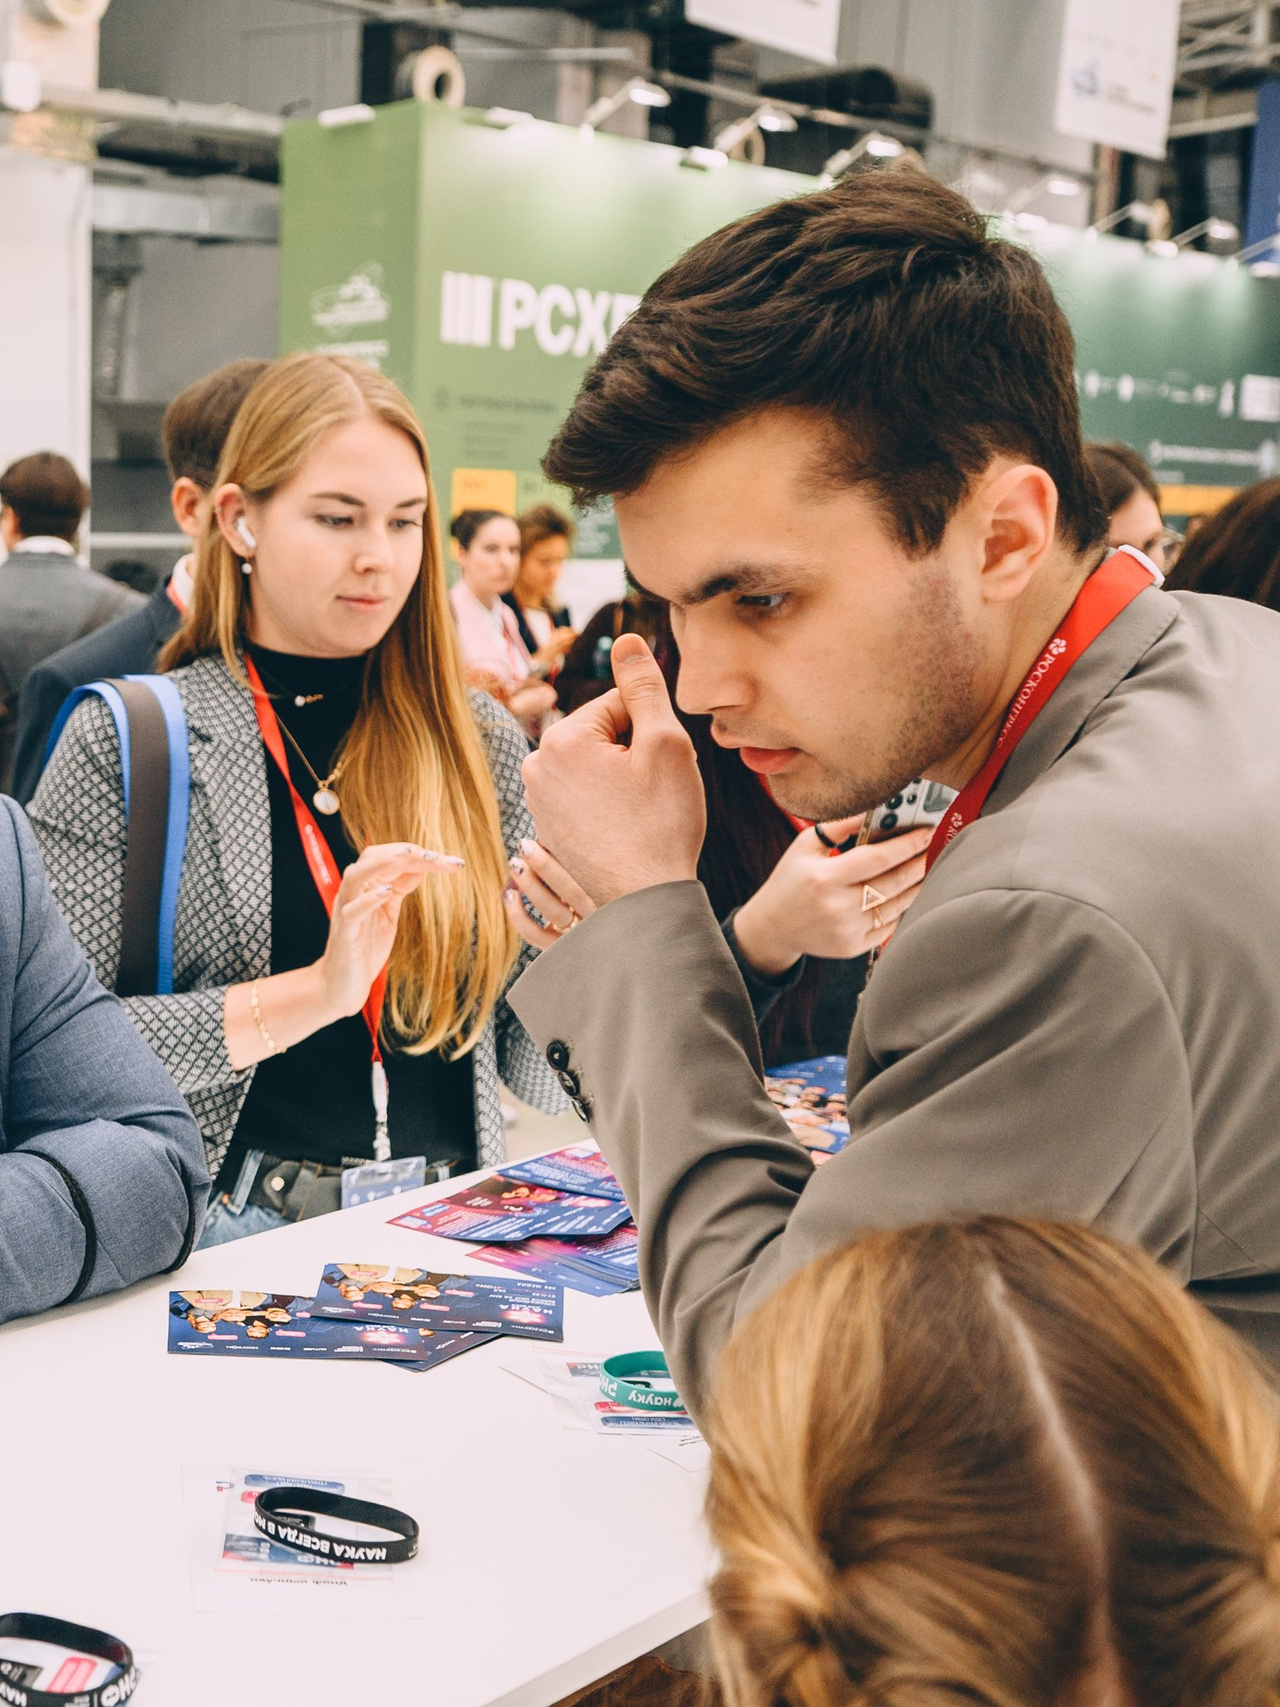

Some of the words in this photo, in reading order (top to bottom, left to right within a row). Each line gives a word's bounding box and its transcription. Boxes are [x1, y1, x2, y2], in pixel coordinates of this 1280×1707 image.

[628, 1389, 672, 1408] науку
[267, 1522, 276, 1536] В
[277, 1525, 331, 1553] ВСЕГДА
[333, 1543, 387, 1560] НАУКА
